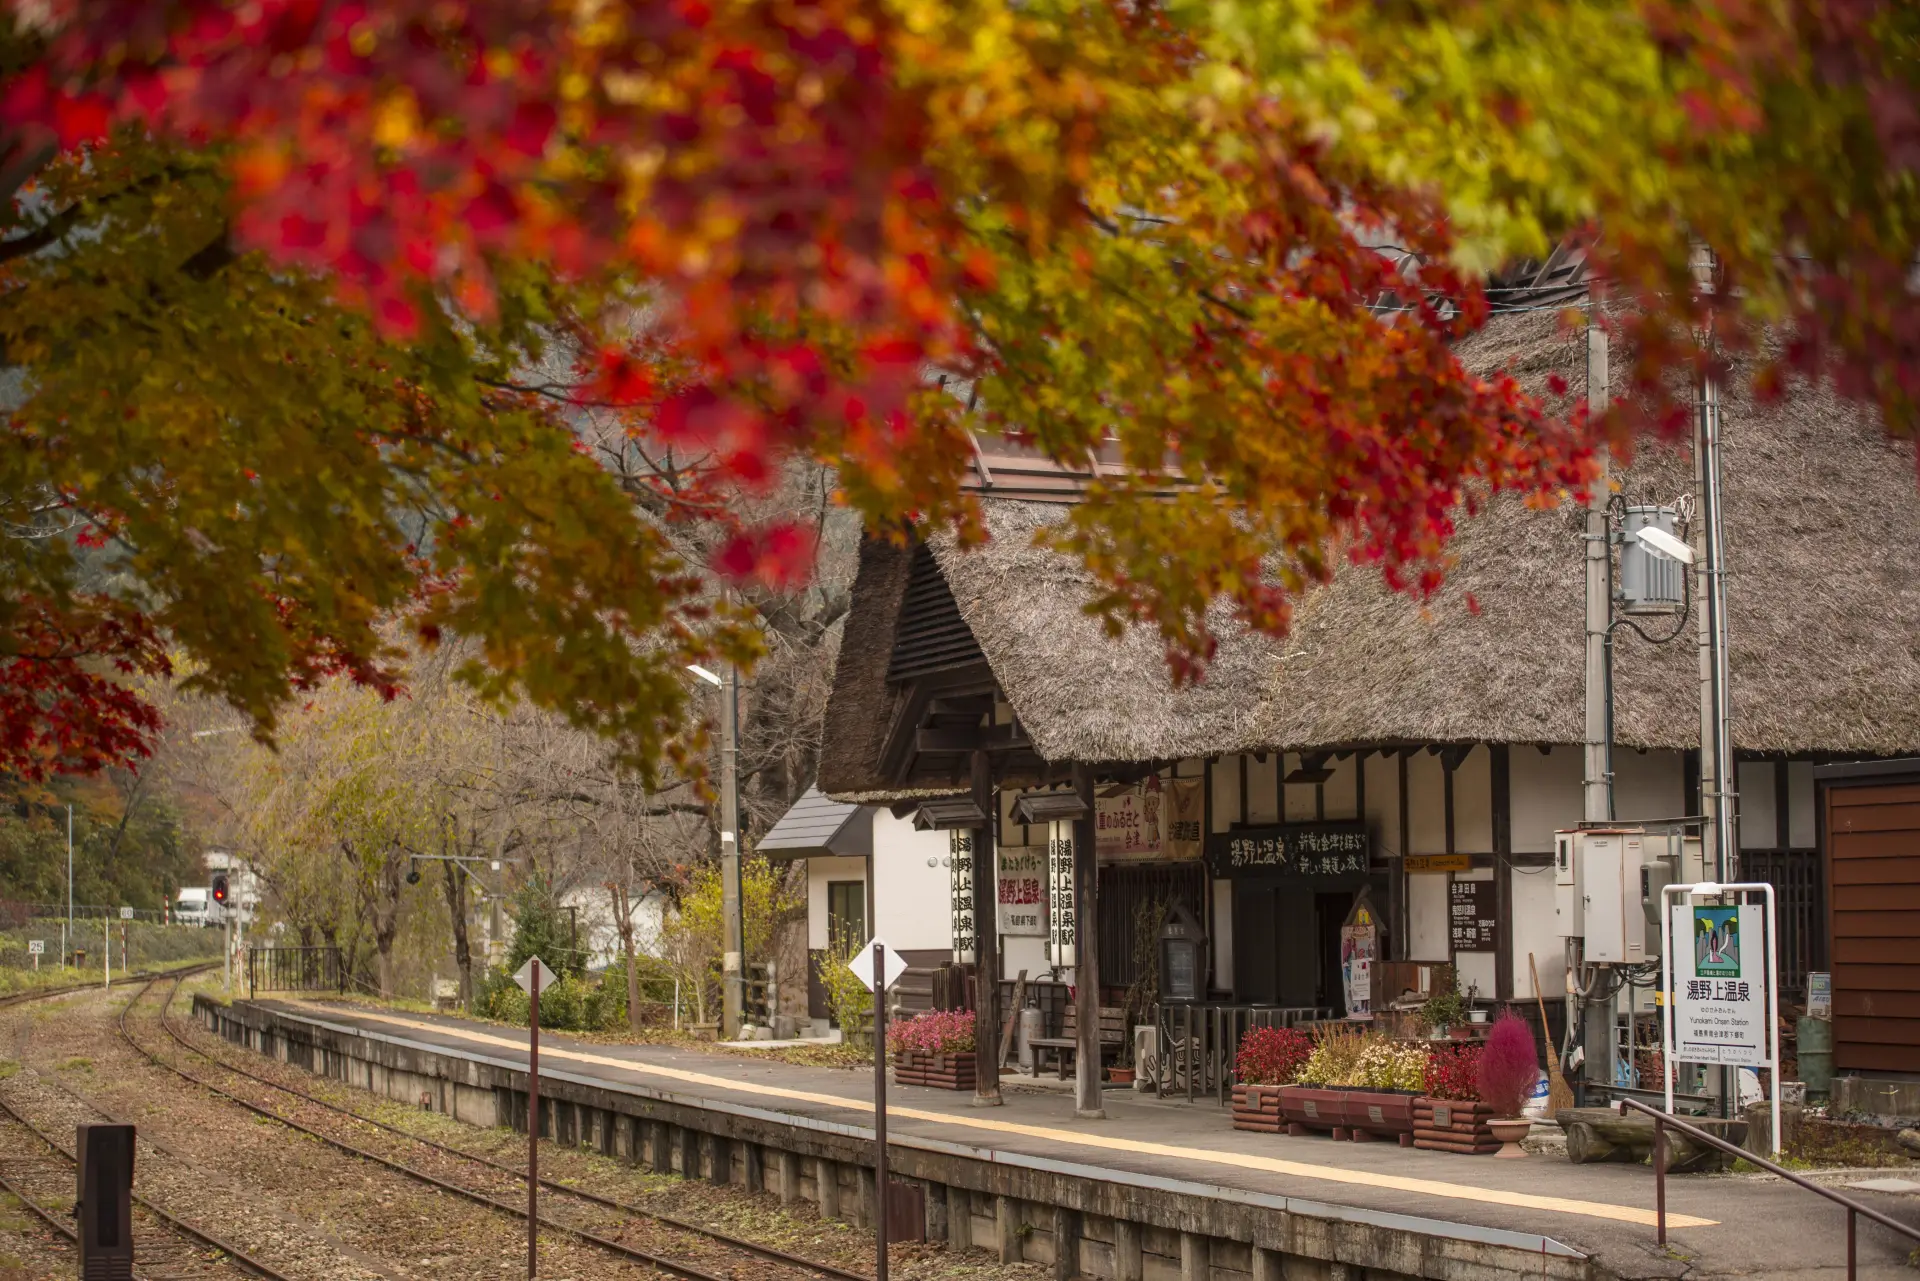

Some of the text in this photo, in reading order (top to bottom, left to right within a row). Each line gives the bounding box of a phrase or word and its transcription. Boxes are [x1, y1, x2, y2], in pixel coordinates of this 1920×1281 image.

[1231, 836, 1287, 867] 湯野上温泉
[1060, 839, 1075, 946] 湯野上温泉駅
[1452, 883, 1476, 894] 会津田島
[959, 837, 974, 952] 湯野上温泉駅
[1452, 904, 1476, 916] 鬼怒川温泉
[1452, 927, 1477, 938] 浅草・新宿
[30, 942, 43, 953] 25
[1686, 980, 1751, 1002] 湯野上温泉
[1689, 1016, 1749, 1026] Yunokami Onsen Station
[1693, 1029, 1744, 1039] 福島県南会津郡下郷町
